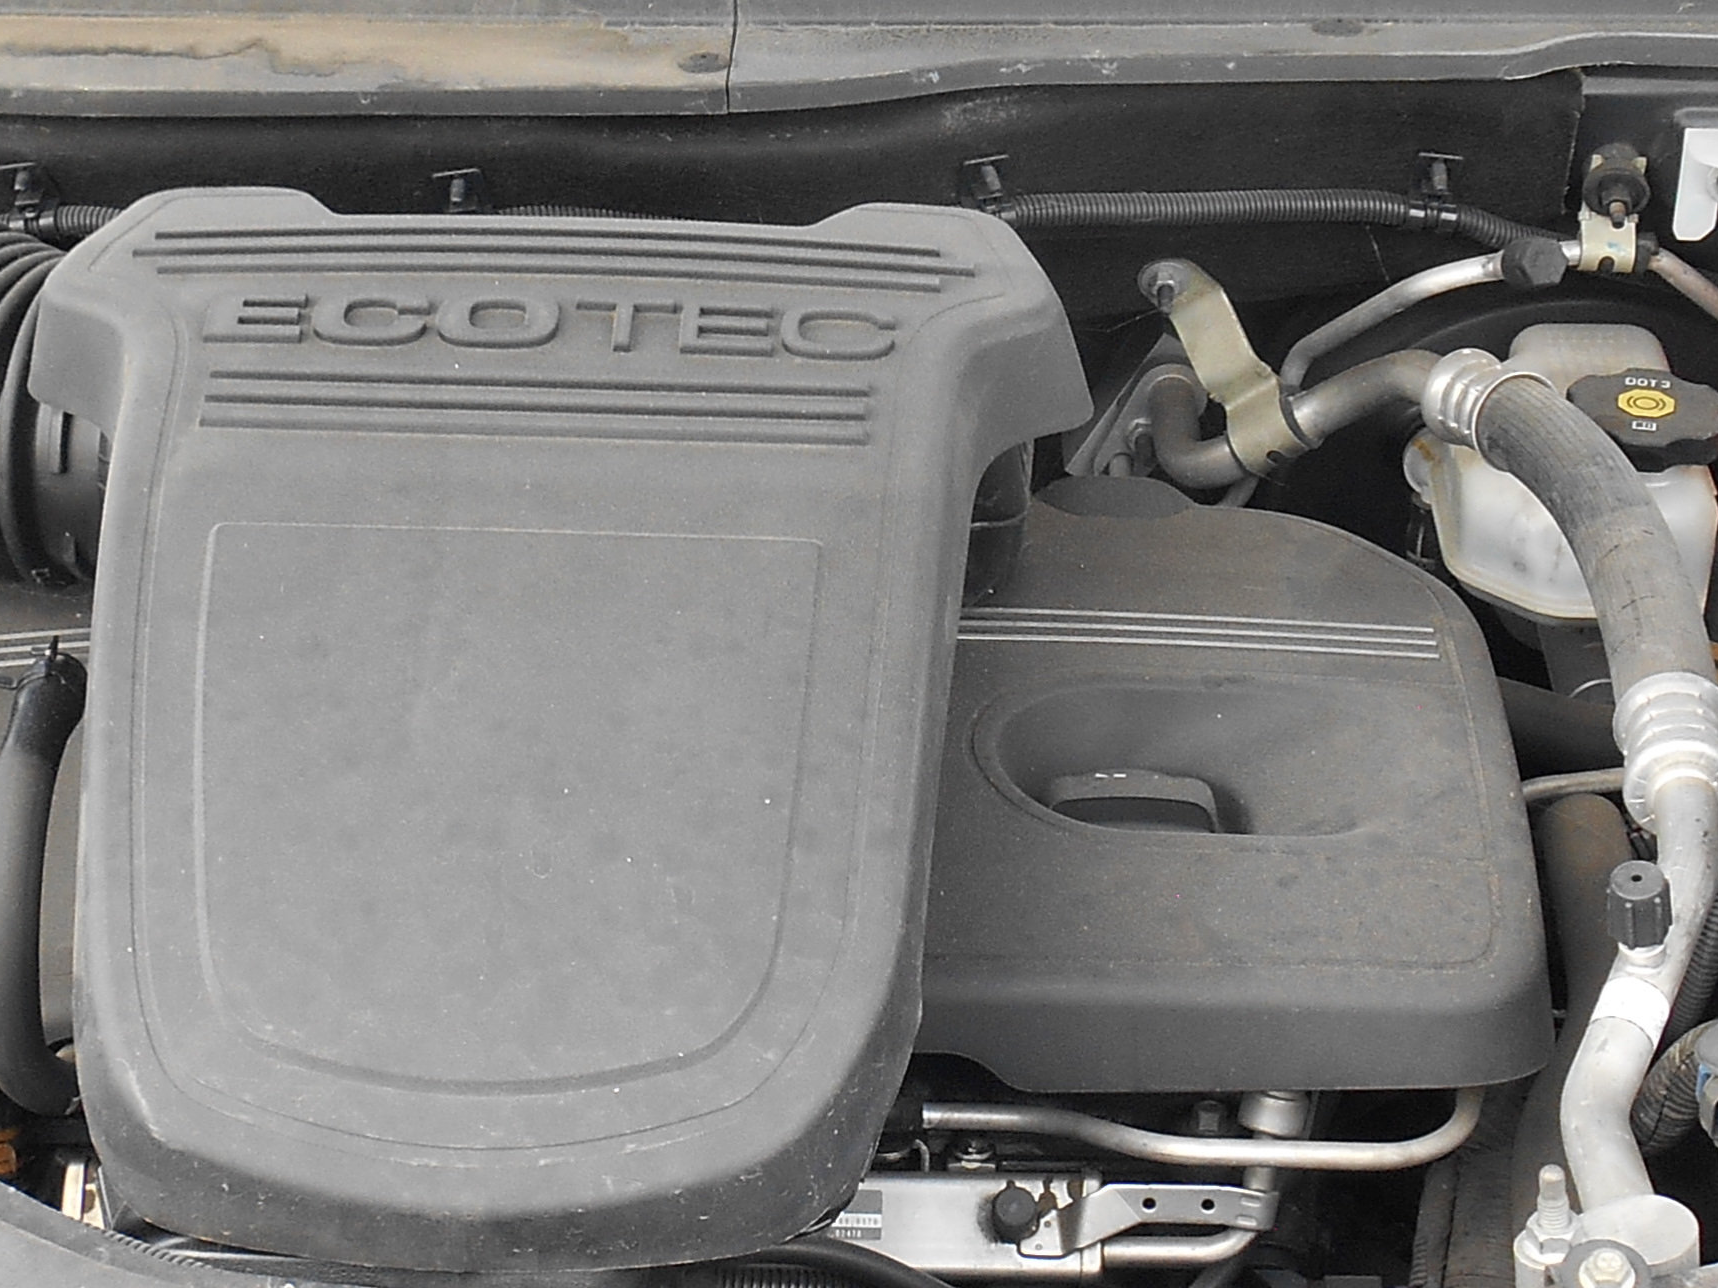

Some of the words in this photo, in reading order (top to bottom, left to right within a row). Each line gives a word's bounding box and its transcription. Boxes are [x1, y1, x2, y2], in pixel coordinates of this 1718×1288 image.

[202, 293, 896, 362] ECOTEC
[1625, 376, 1658, 388] DOT
[1661, 380, 1671, 389] 3
